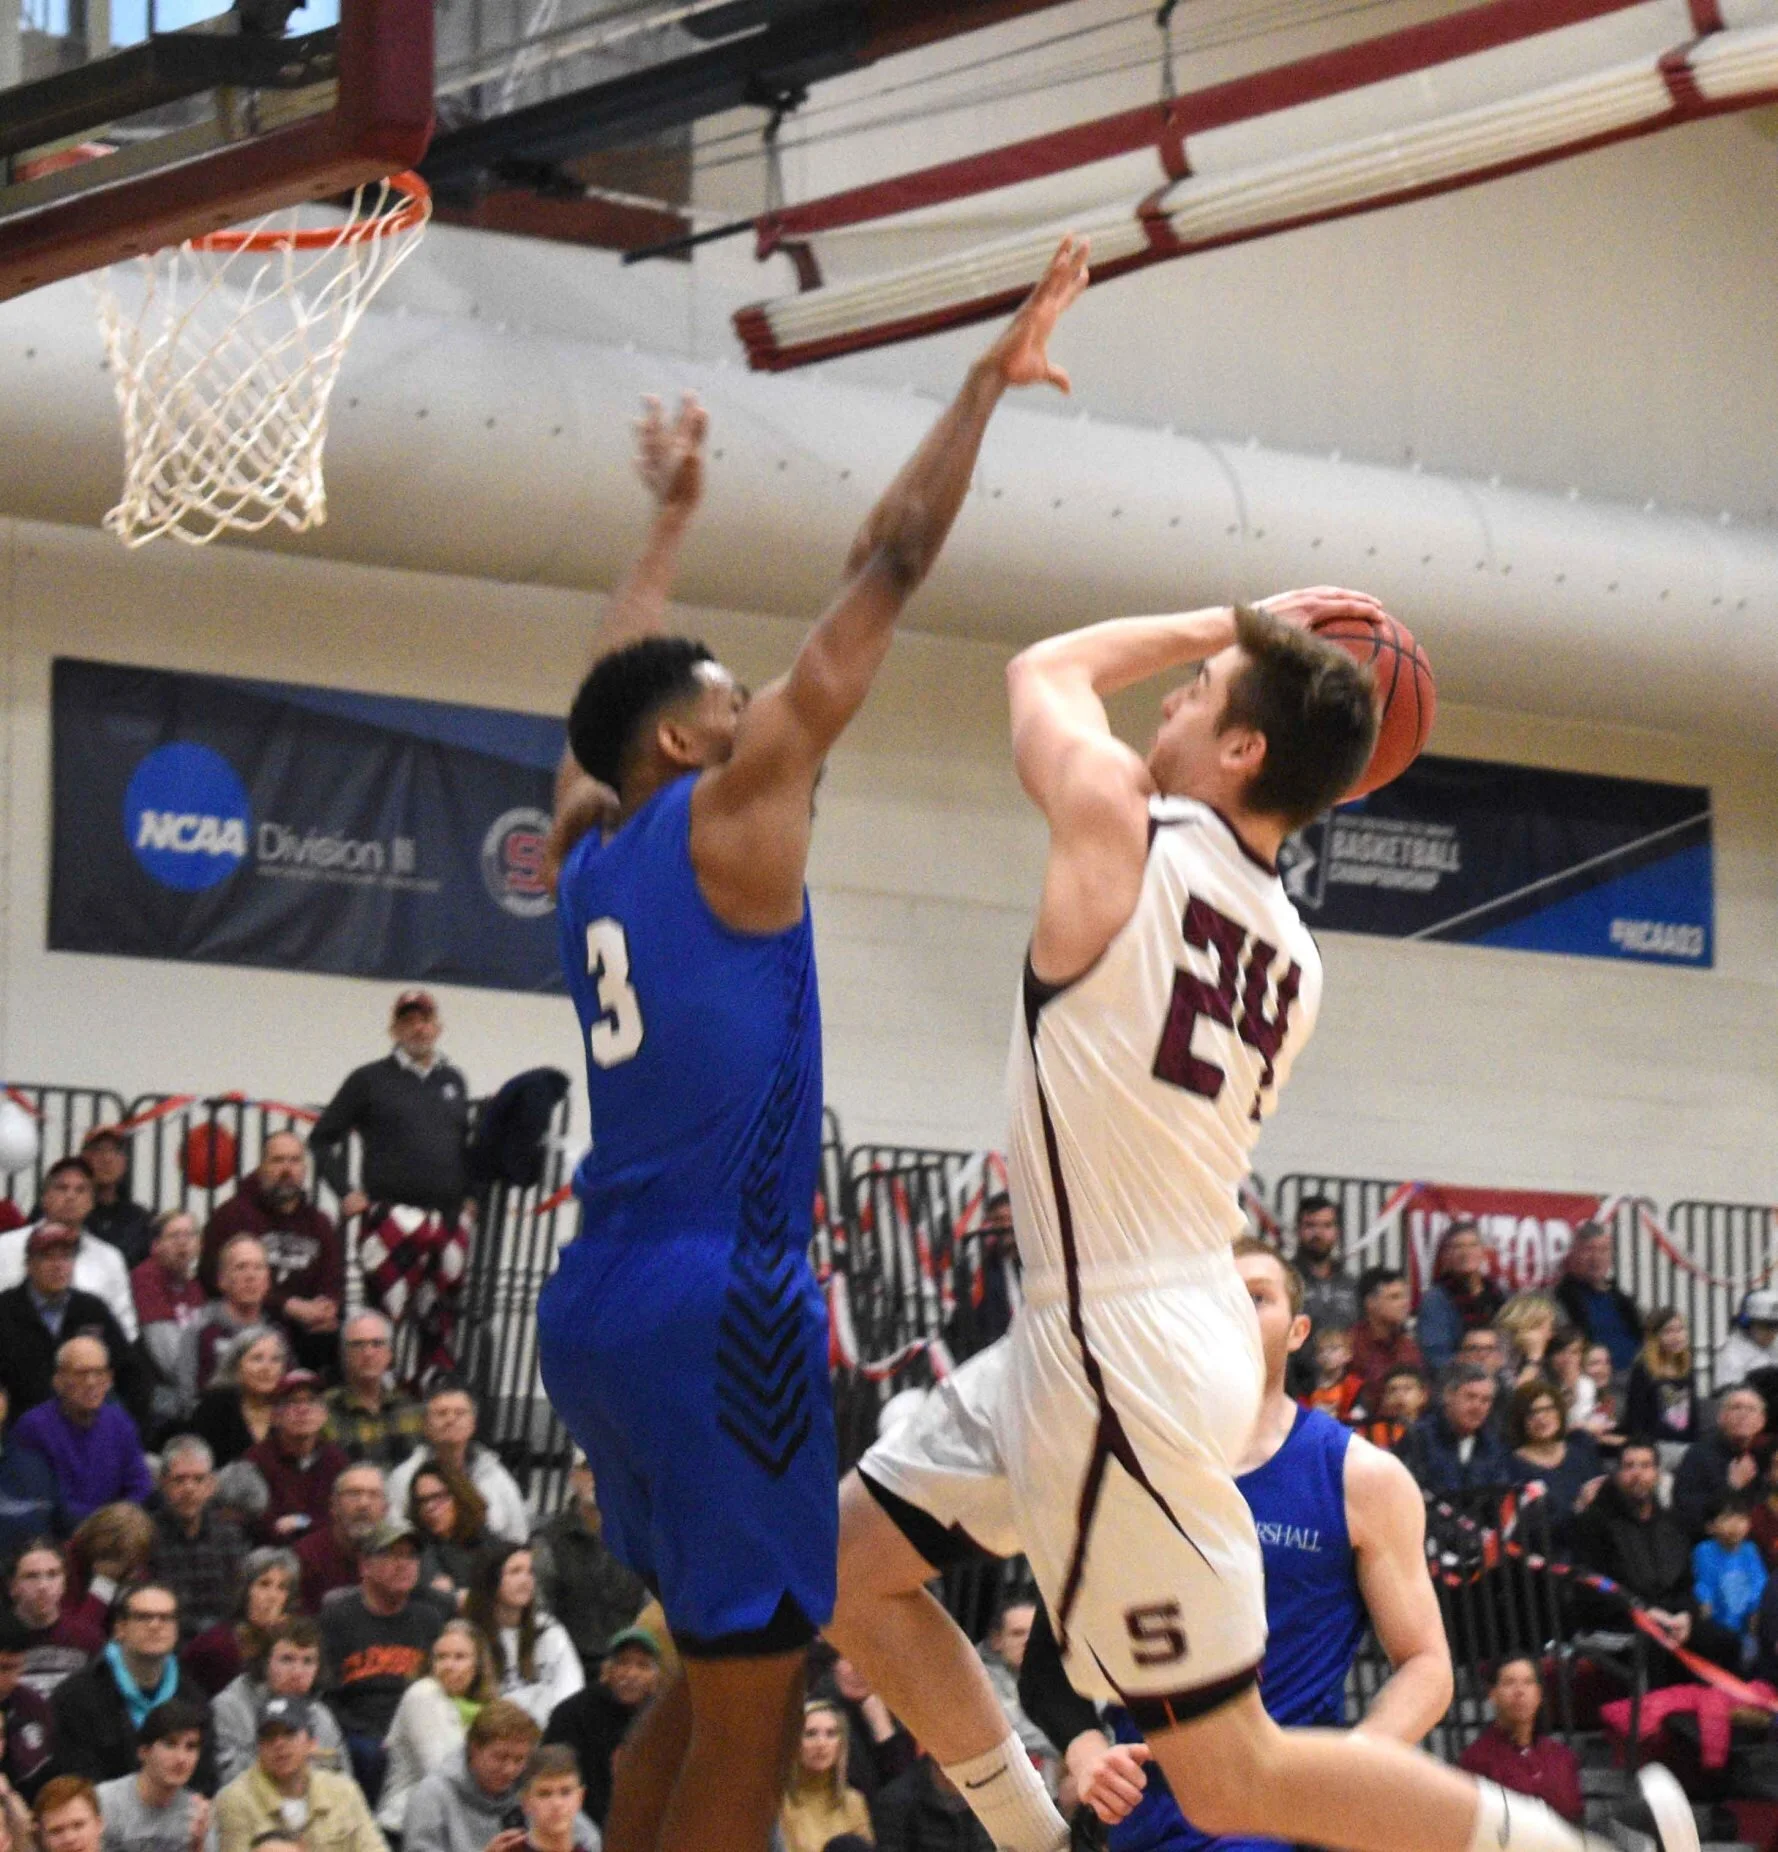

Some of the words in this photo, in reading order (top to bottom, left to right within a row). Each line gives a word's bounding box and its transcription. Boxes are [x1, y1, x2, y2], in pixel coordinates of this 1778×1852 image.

[137, 810, 247, 857] NCAA
[257, 822, 384, 870] Division
[1331, 829, 1461, 873] BASKETBALL
[586, 916, 644, 1070] 3
[1153, 893, 1301, 1122] 24
[1124, 1601, 1187, 1668] S
